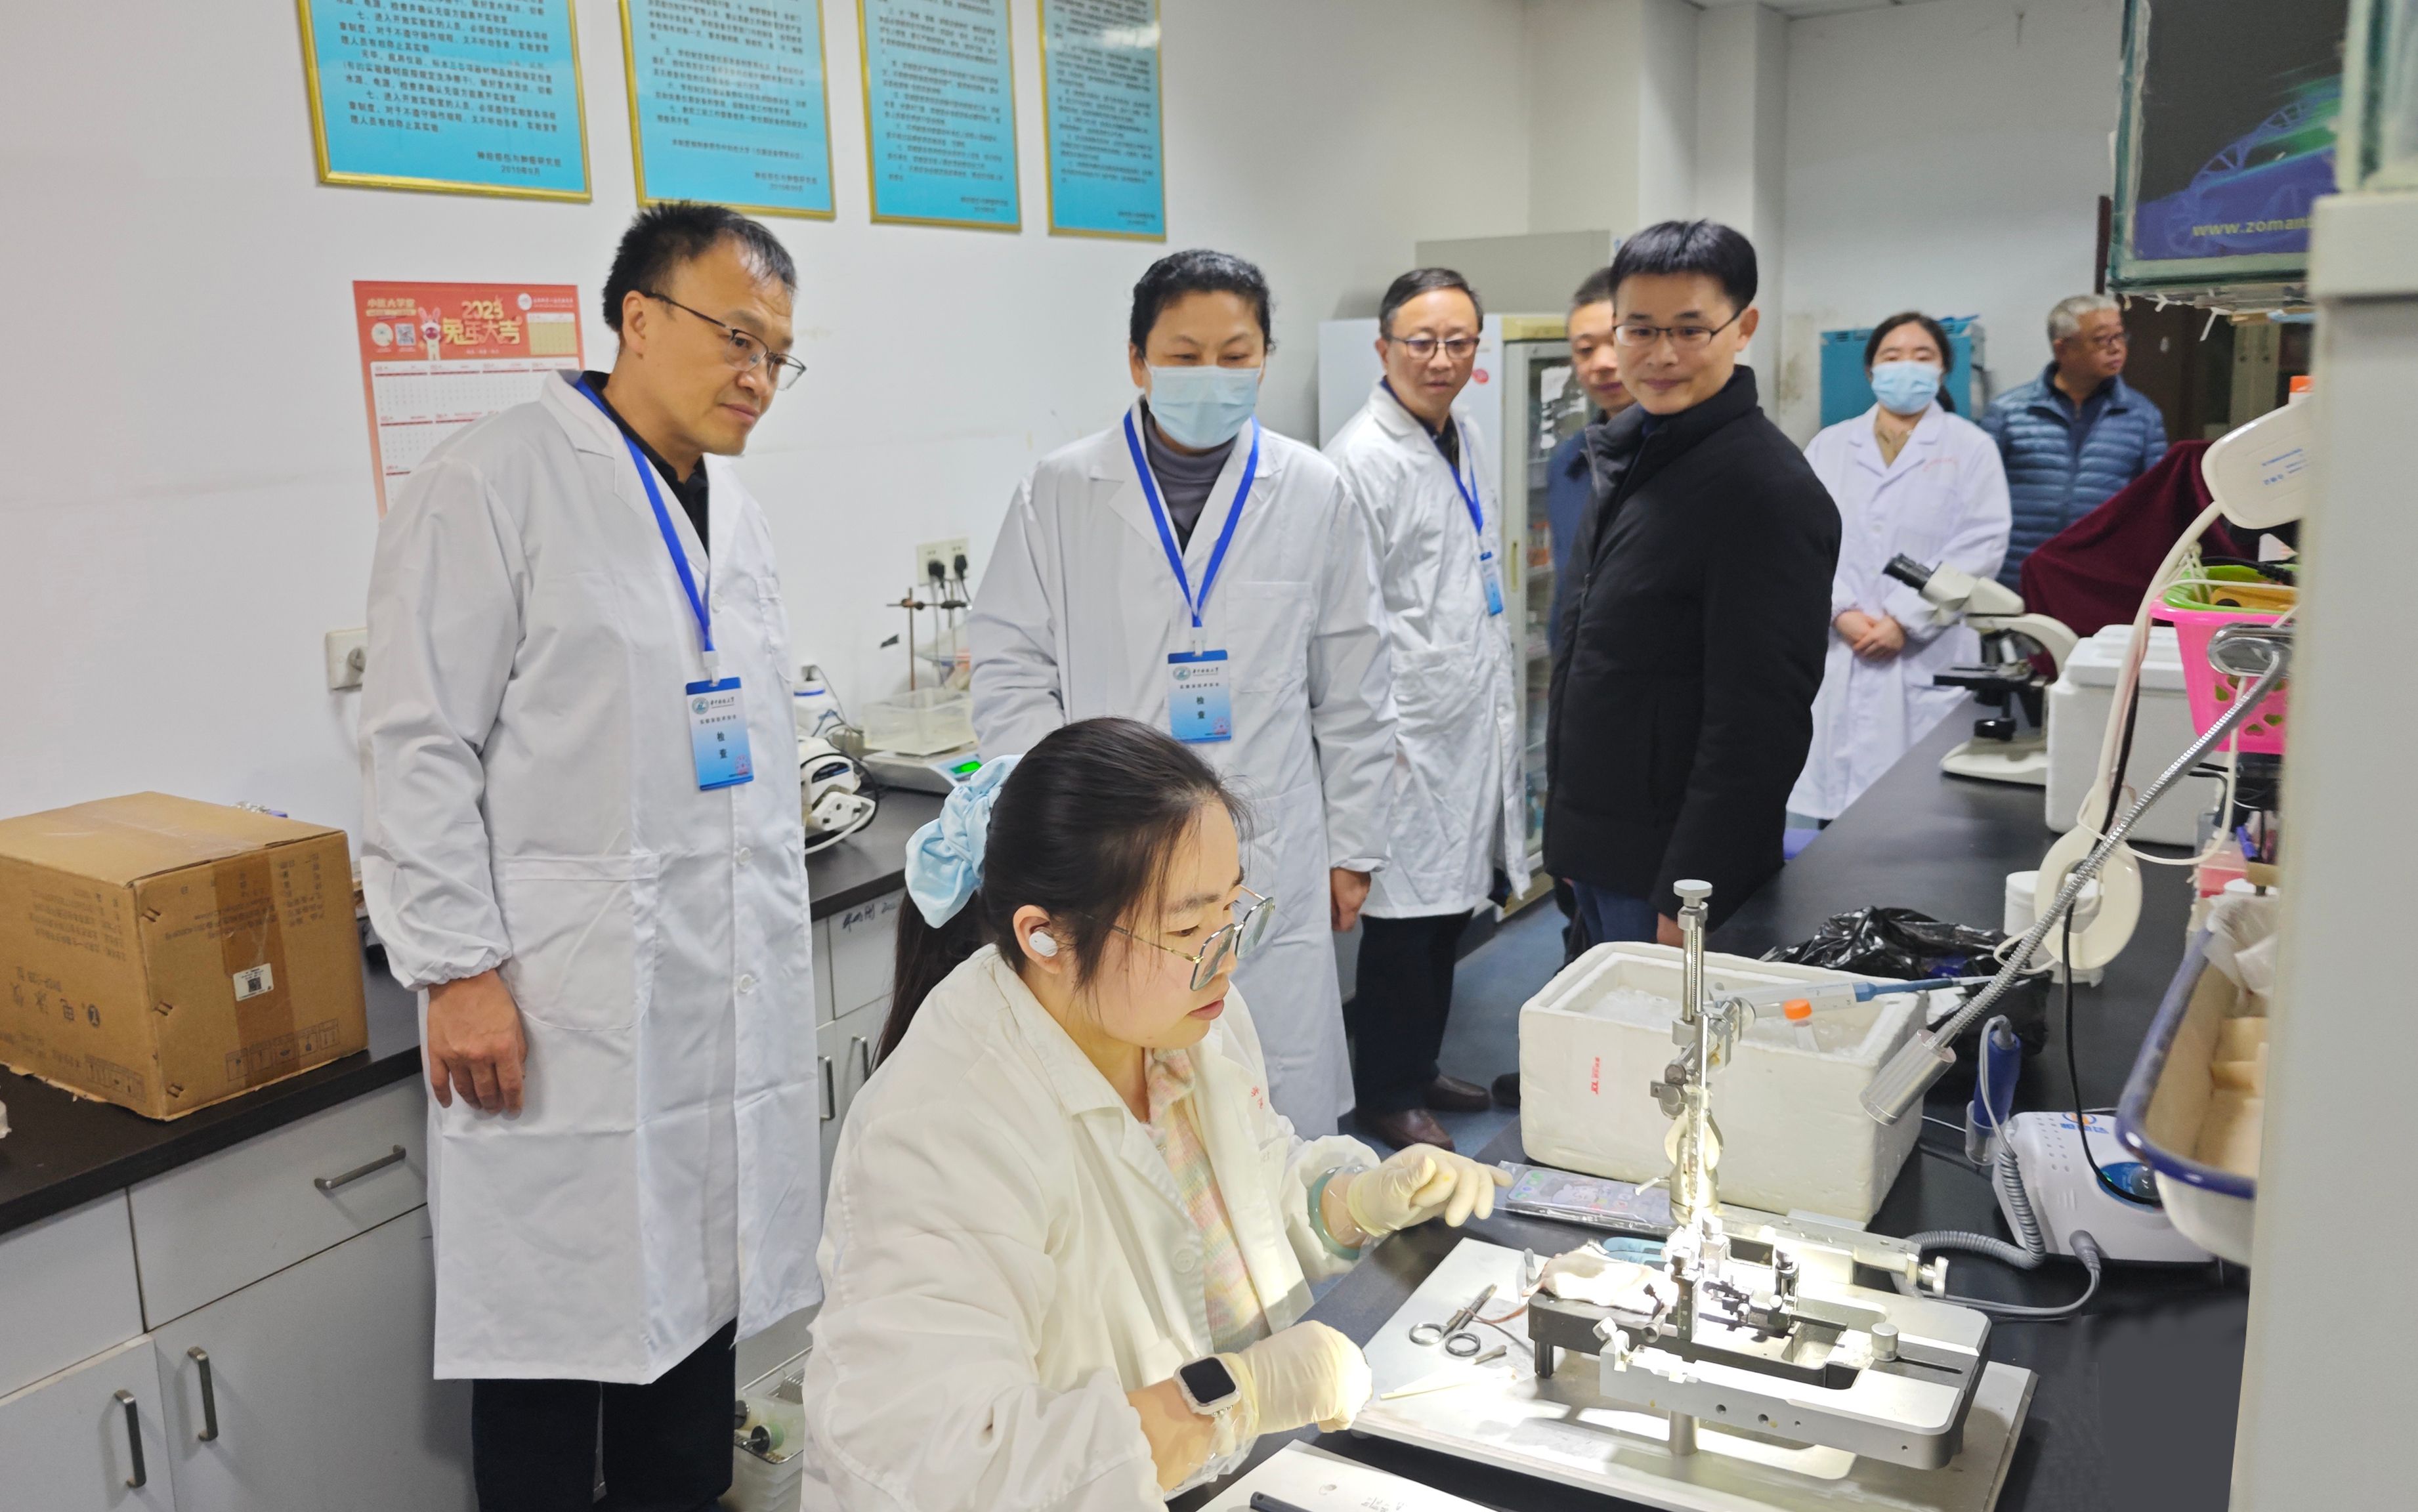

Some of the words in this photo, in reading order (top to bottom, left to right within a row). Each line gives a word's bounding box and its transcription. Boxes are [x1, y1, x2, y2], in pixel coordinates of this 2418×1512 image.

[461, 299, 504, 320] 2023
[442, 316, 522, 346] 兔年大吉
